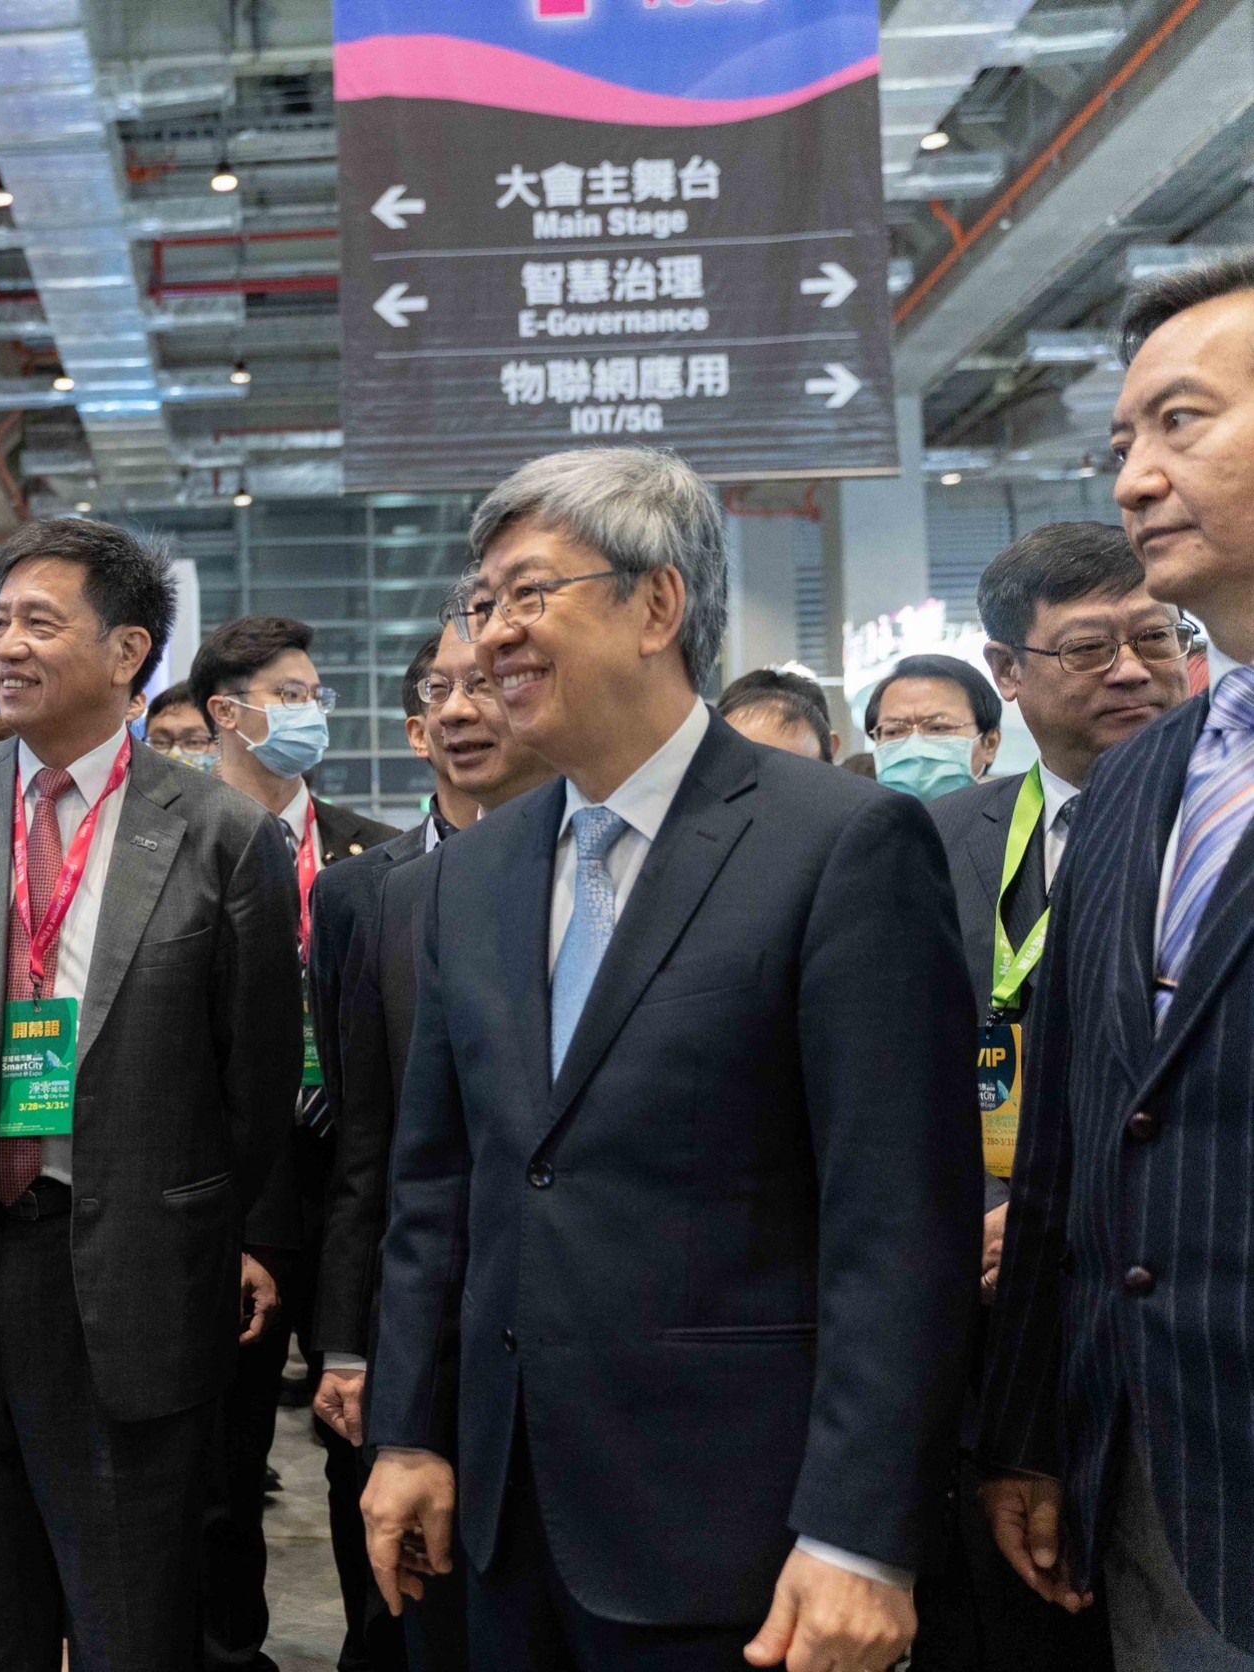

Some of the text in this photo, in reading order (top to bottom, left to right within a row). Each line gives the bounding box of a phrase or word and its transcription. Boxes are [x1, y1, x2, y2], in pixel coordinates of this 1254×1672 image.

[496, 155, 722, 209] 大會主舞台
[532, 206, 689, 240] Main Stage
[521, 254, 705, 306] 智慧治理
[518, 306, 710, 338] E-Governance
[500, 354, 730, 406] 物聯網應用
